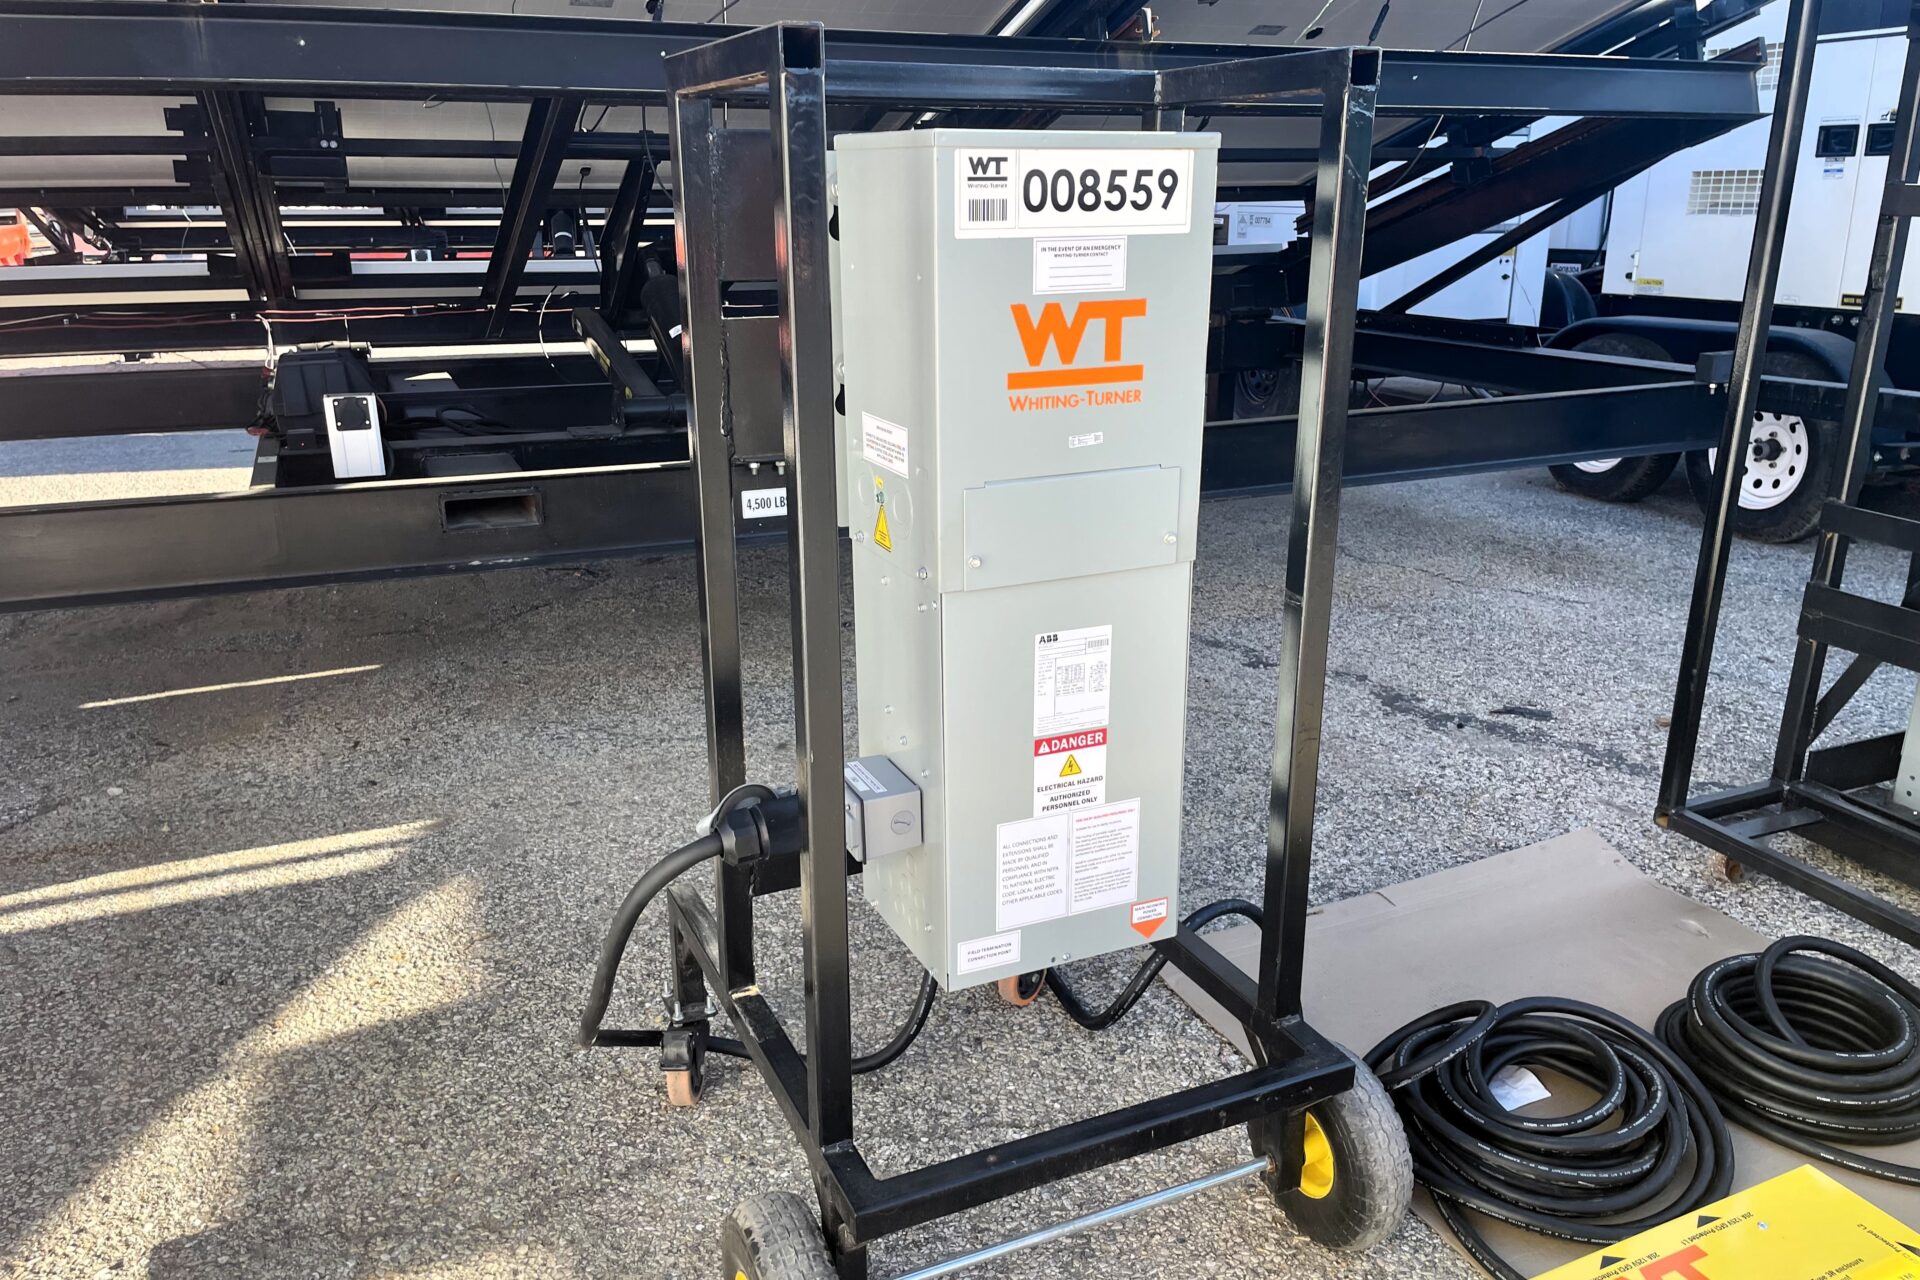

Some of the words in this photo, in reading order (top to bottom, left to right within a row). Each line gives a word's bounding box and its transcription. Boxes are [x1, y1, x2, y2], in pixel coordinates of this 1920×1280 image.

[968, 157, 1008, 175] WT
[1023, 168, 1179, 213] 008559
[1010, 298, 1148, 366] WT
[1008, 388, 1143, 412] WHITING-TURNER
[747, 497, 771, 512] 4,500
[775, 496, 786, 508] LB
[1039, 633, 1058, 644] ABB
[1051, 732, 1104, 752] DANGER
[1037, 780, 1076, 793] ELECTRICAL
[1077, 775, 1104, 786] HAZARD
[1049, 789, 1091, 802] AUTHORIZED
[1041, 800, 1080, 812] PERSONNEL
[1081, 796, 1098, 804] ONLY
[1012, 837, 1046, 848] CONNECTIONS
[1002, 848, 1032, 858] EXTENSIONS
[1002, 858, 1017, 866] MADE
[1025, 852, 1049, 862] QUALIFIED
[1002, 863, 1030, 874] PERSONNEL
[1002, 871, 1033, 882] COMPLIANCE
[1010, 879, 1033, 889] NATIONAL
[1002, 898, 1018, 906] OTHER
[1019, 892, 1046, 902] APPLICABLE
[1047, 888, 1063, 897] CODES
[1017, 887, 1033, 895] LOCAL
[981, 942, 1012, 953] TERMINATION
[968, 953, 997, 963] CONNECTION
[1716, 1222, 1728, 1233] GFCI
[1727, 1216, 1742, 1227] 125V
[1688, 1227, 1716, 1244] Protected
[1867, 1230, 1901, 1252] Protected
[1633, 1256, 1648, 1268] 125V
[1835, 1257, 1865, 1274] enclosure
[1592, 1269, 1618, 1280] Protec
[1619, 1263, 1633, 1274] GFCI
